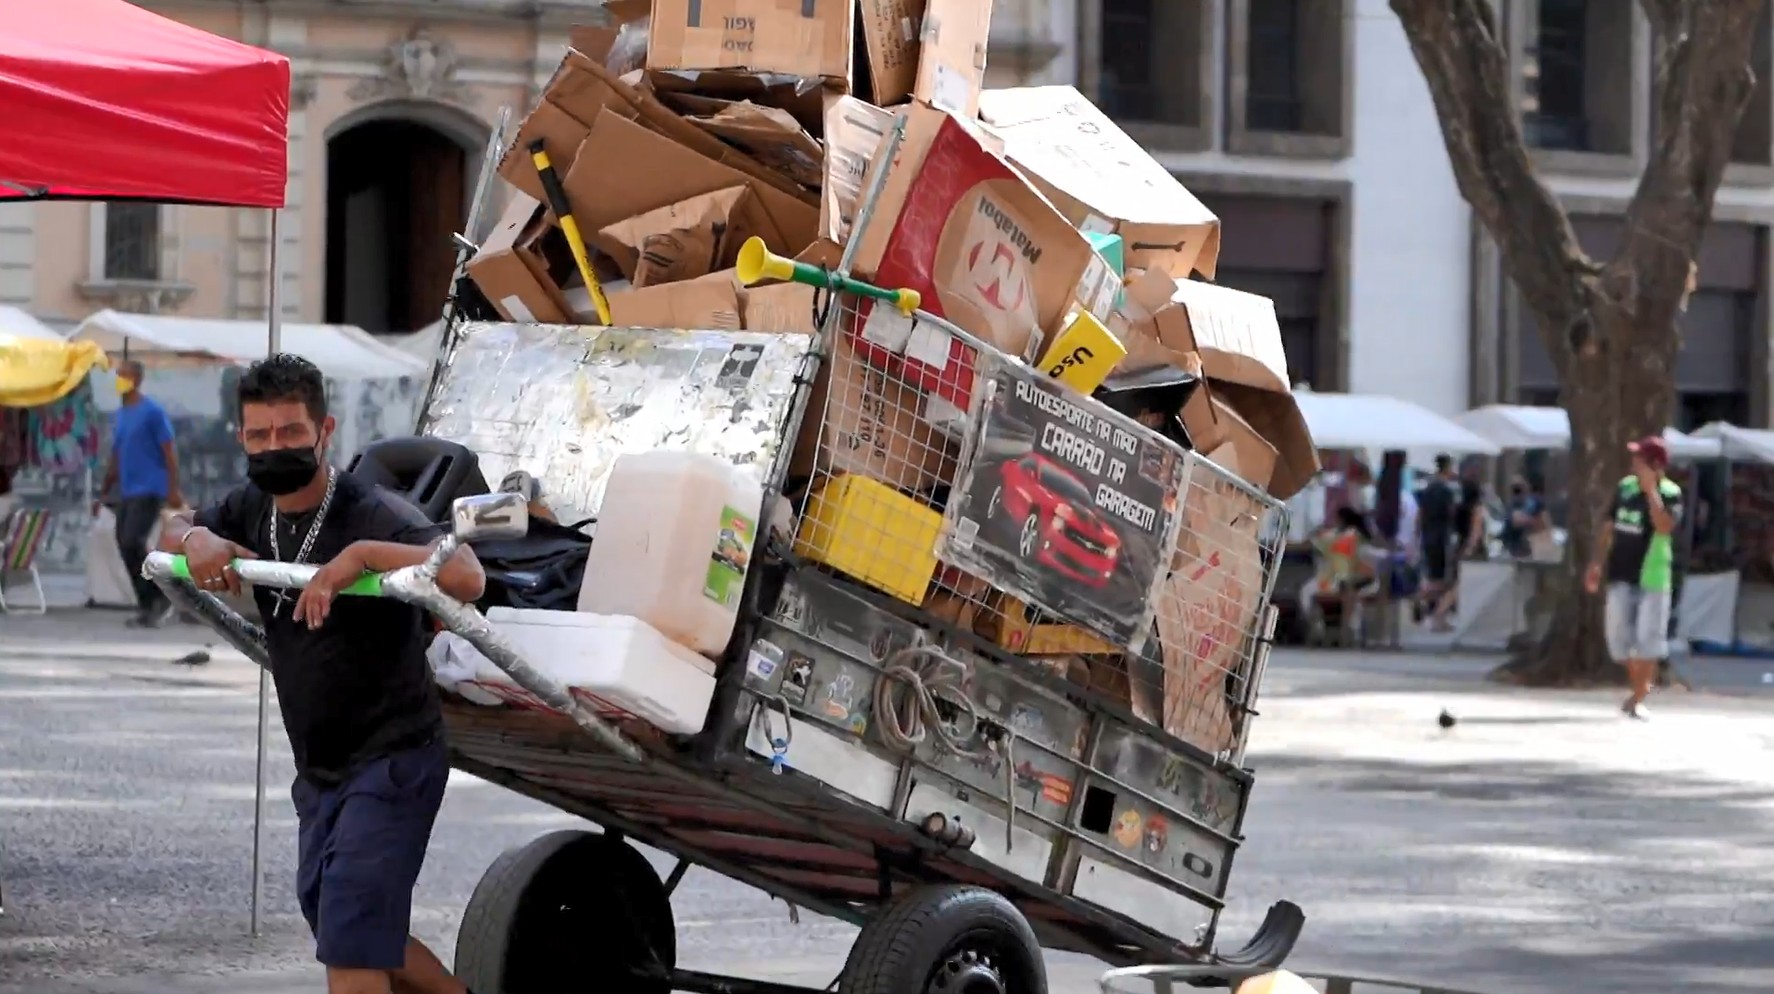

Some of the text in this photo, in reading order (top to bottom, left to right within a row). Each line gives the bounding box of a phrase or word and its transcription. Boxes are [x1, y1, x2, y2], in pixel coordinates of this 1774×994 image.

[1016, 380, 1095, 433] AUTOESPORTE
[1096, 419, 1112, 442] NA
[1041, 422, 1127, 485] CARRÃO NA
[1095, 484, 1156, 531] GARAGEM
